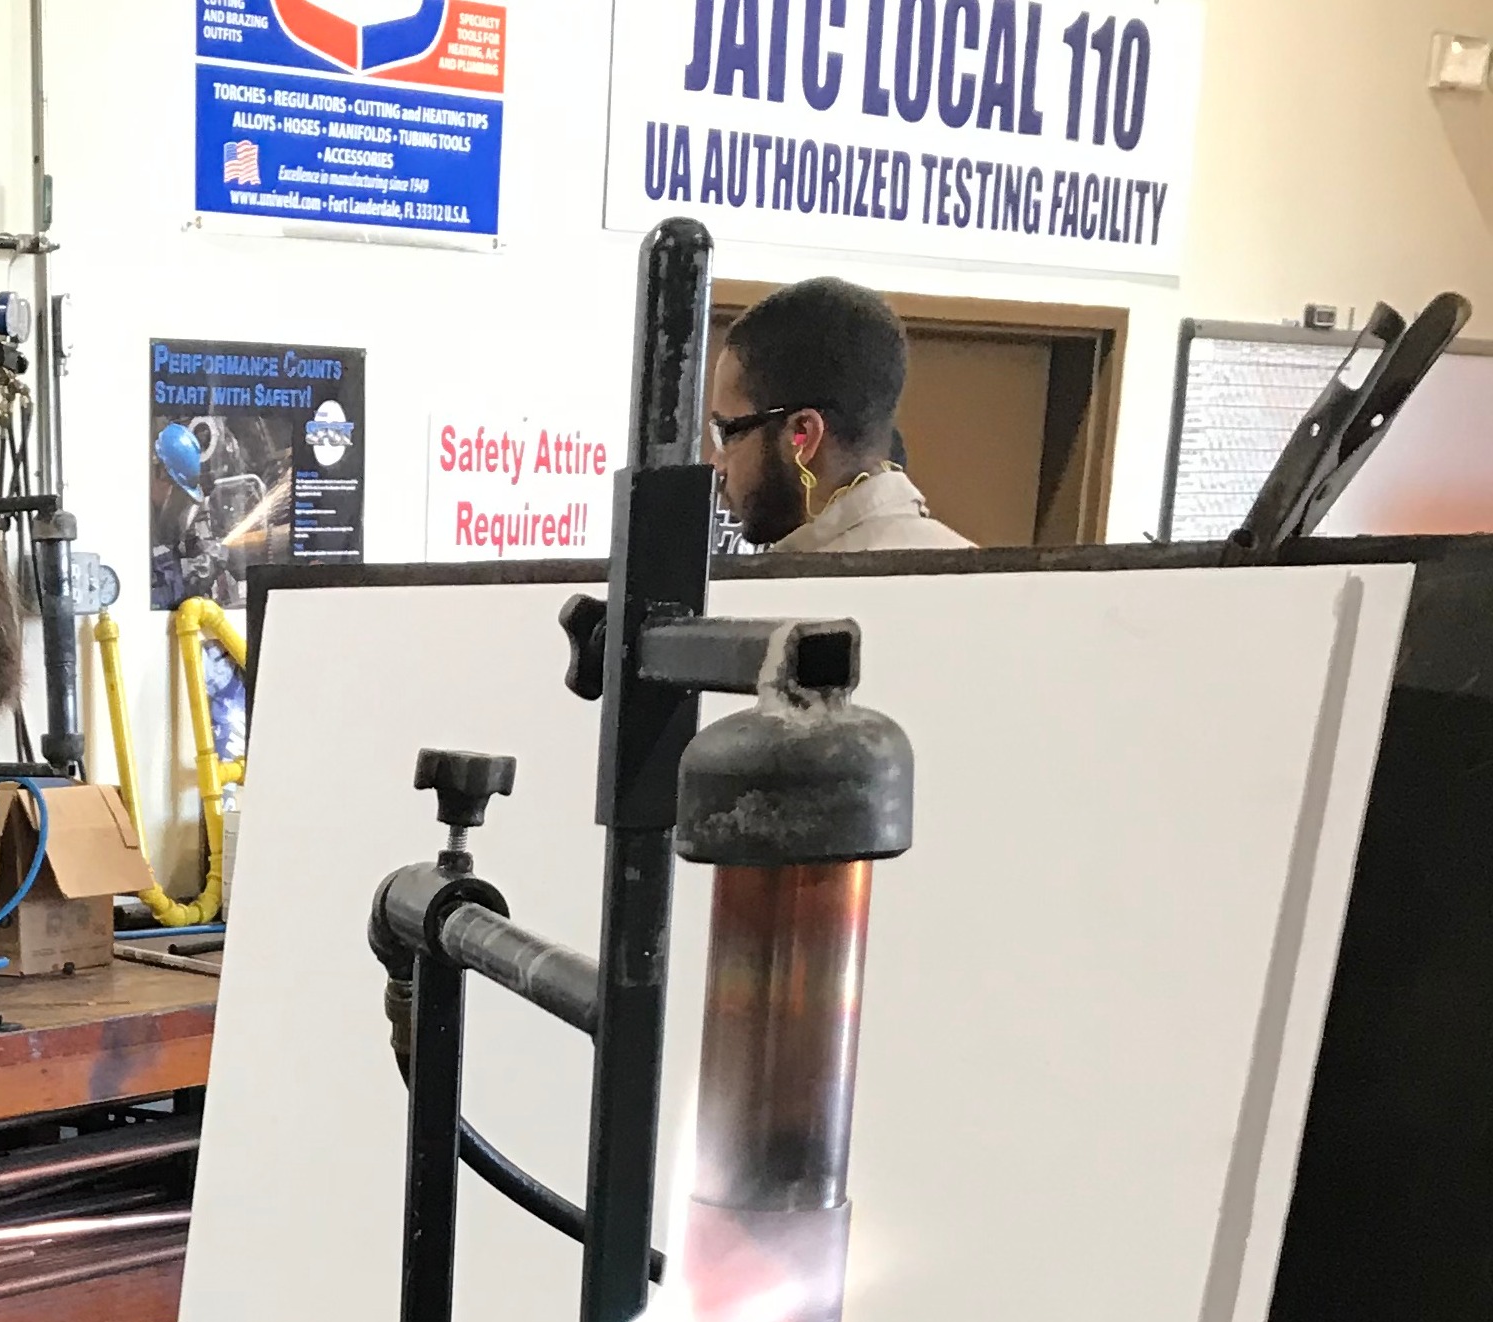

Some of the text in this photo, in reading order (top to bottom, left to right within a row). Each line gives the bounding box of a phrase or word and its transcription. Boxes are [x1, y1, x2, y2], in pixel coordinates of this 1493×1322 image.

[204, 9, 268, 29] AND BRAZING
[459, 12, 500, 29] SPECIALTY
[203, 26, 243, 42] OUTFITS
[457, 28, 500, 45] TOOLS FOR
[438, 57, 456, 70] AND
[486, 47, 500, 60] A/C
[862, 0, 1044, 136] LOCAL
[1062, 11, 1151, 151] 110
[213, 82, 488, 129] TORCHES REGULATORS CUTTING and HEATING TIPS
[232, 111, 471, 152] ALLOYS HOSES MANIFOLDS TUBING TOOLS
[324, 147, 394, 169] ACCESSORIES
[320, 169, 328, 184] in
[389, 176, 409, 191] since
[645, 120, 1169, 246] UA AUTHORIZED TESTING FACILITY
[230, 189, 321, 211] www.uniweld.com
[328, 194, 348, 213] Fort
[349, 197, 403, 220] Lauderdale,
[404, 201, 415, 220] FL
[445, 205, 470, 224] U.S.A.
[212, 386, 251, 406] WITH
[440, 425, 607, 485] Safety Attire
[456, 501, 588, 557] Required!!
